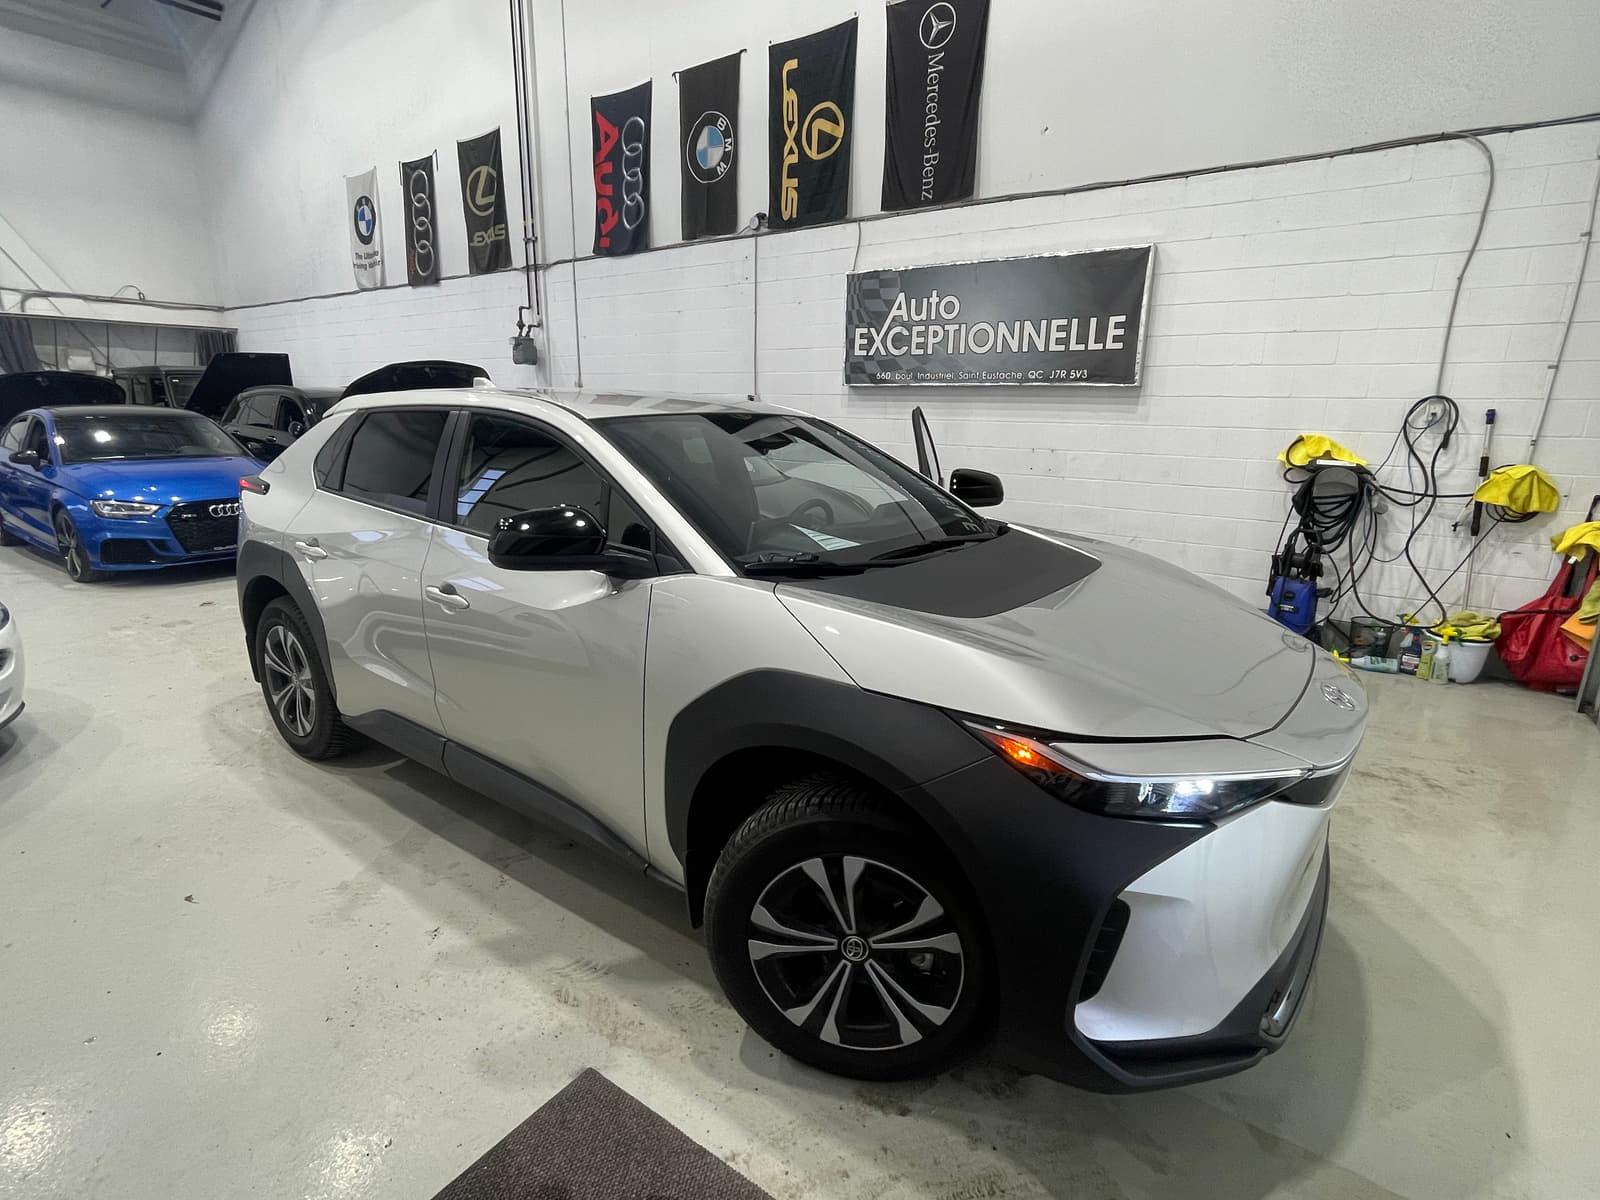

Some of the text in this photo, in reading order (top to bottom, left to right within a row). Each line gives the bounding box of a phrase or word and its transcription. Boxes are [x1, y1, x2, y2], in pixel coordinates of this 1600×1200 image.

[716, 117, 732, 176] BMW
[781, 58, 799, 222] LEXUS
[921, 51, 945, 201] Mercedes-Benz
[880, 289, 961, 330] Auto
[854, 314, 1127, 357] EXCEPTIONNELLE
[958, 371, 980, 380] Saint
[1028, 370, 1044, 379] QC
[1049, 369, 1067, 379] J7R
[1069, 369, 1088, 379] 5V3
